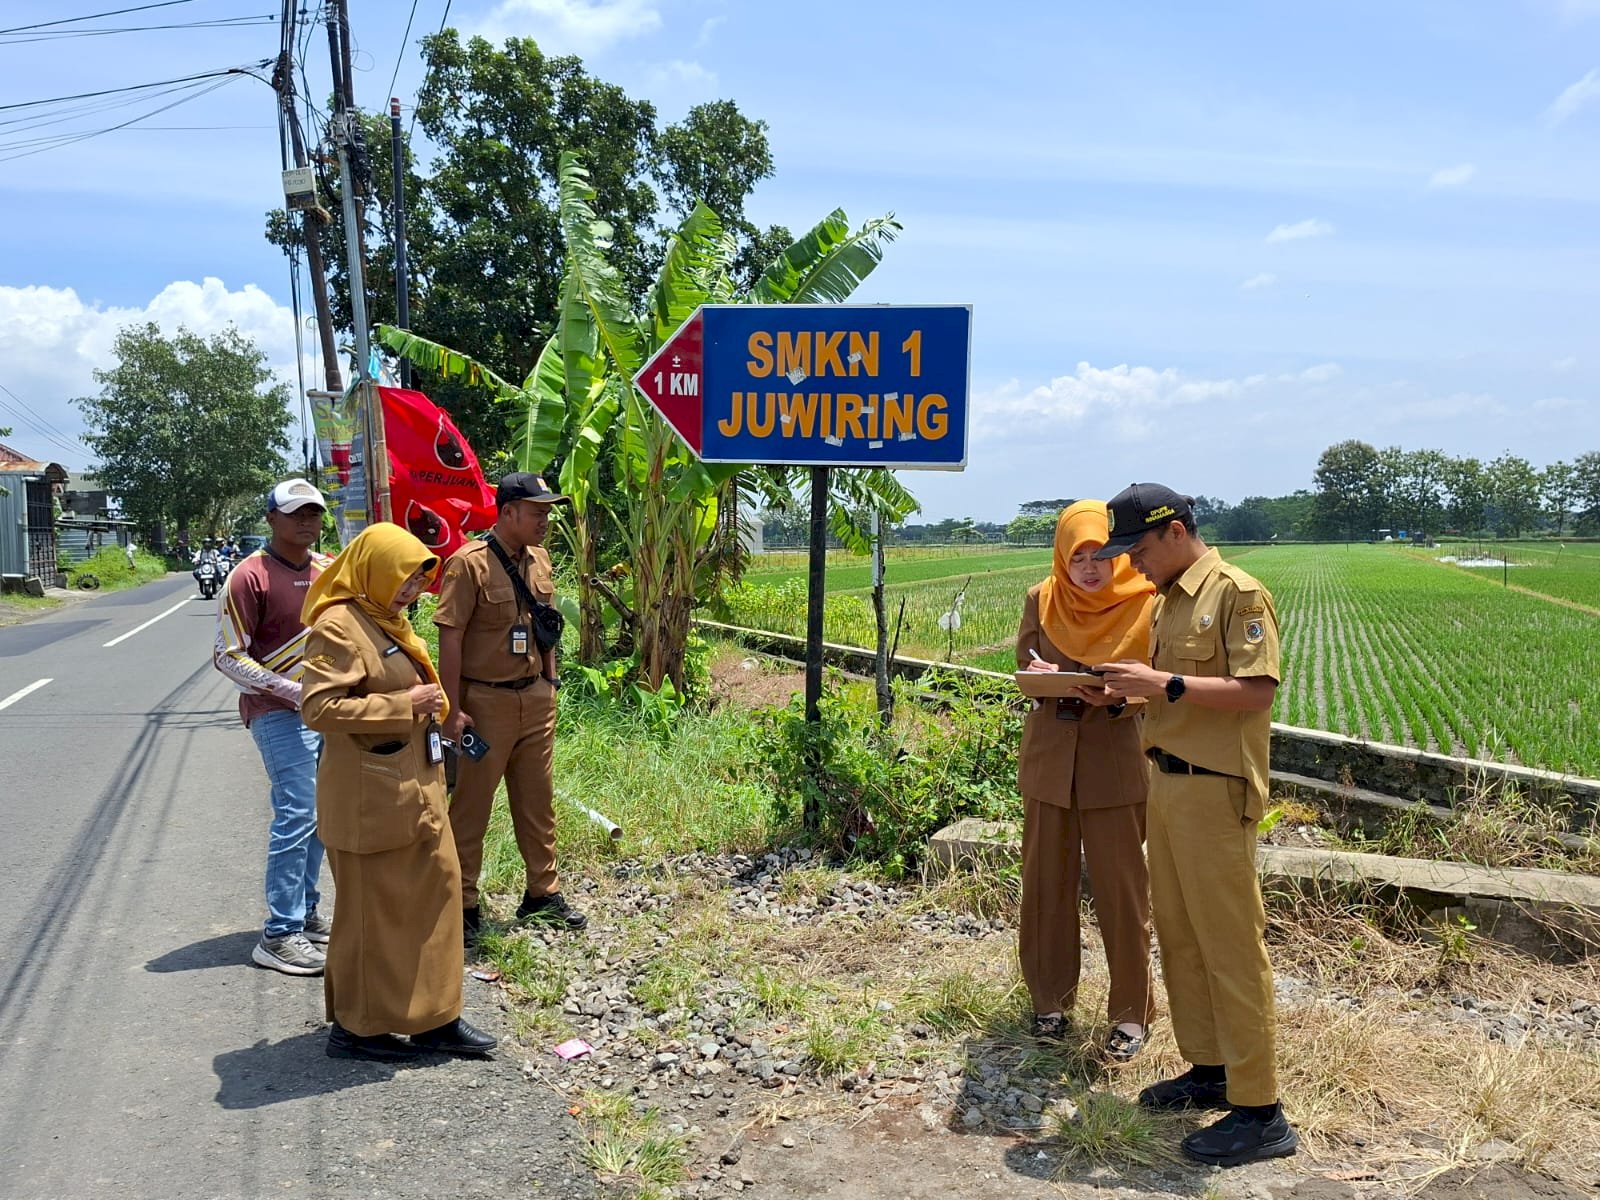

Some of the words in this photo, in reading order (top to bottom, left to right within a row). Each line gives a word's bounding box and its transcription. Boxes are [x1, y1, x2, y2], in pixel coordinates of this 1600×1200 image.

[747, 331, 879, 377] SMKN
[902, 330, 921, 376] 1
[654, 371, 663, 395] 1
[670, 372, 699, 397] KM
[718, 392, 948, 440] JUWIRING
[419, 471, 480, 490] PERJUAN
